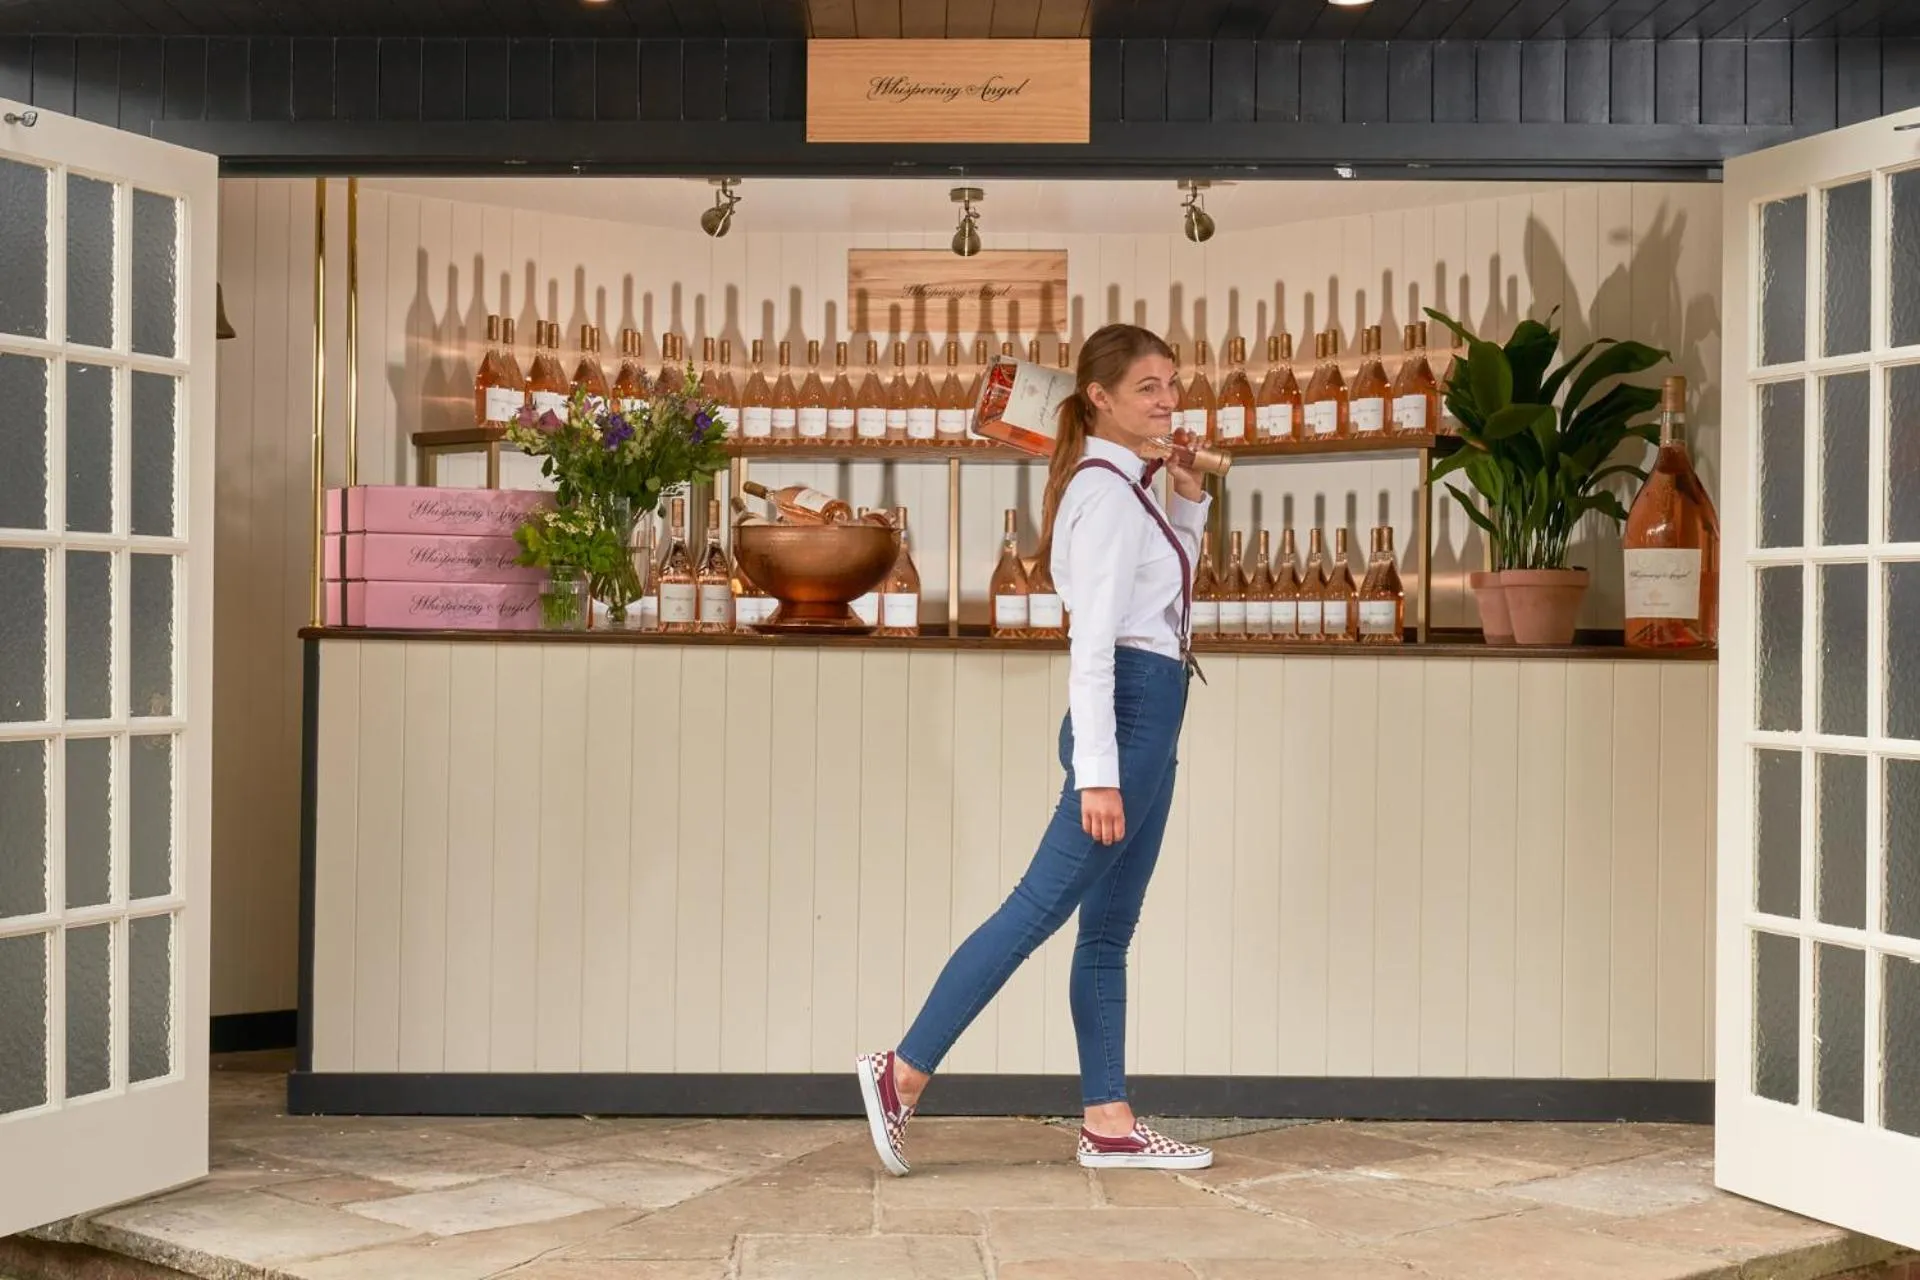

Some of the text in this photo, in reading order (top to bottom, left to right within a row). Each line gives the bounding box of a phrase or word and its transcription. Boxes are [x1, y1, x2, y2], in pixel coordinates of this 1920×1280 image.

[867, 76, 1031, 103] Whispering Angel
[901, 283, 1012, 300] Whispering Angel
[409, 500, 483, 523] Whispering
[408, 546, 482, 569] Whispering
[409, 595, 537, 617] Whispering Angel
